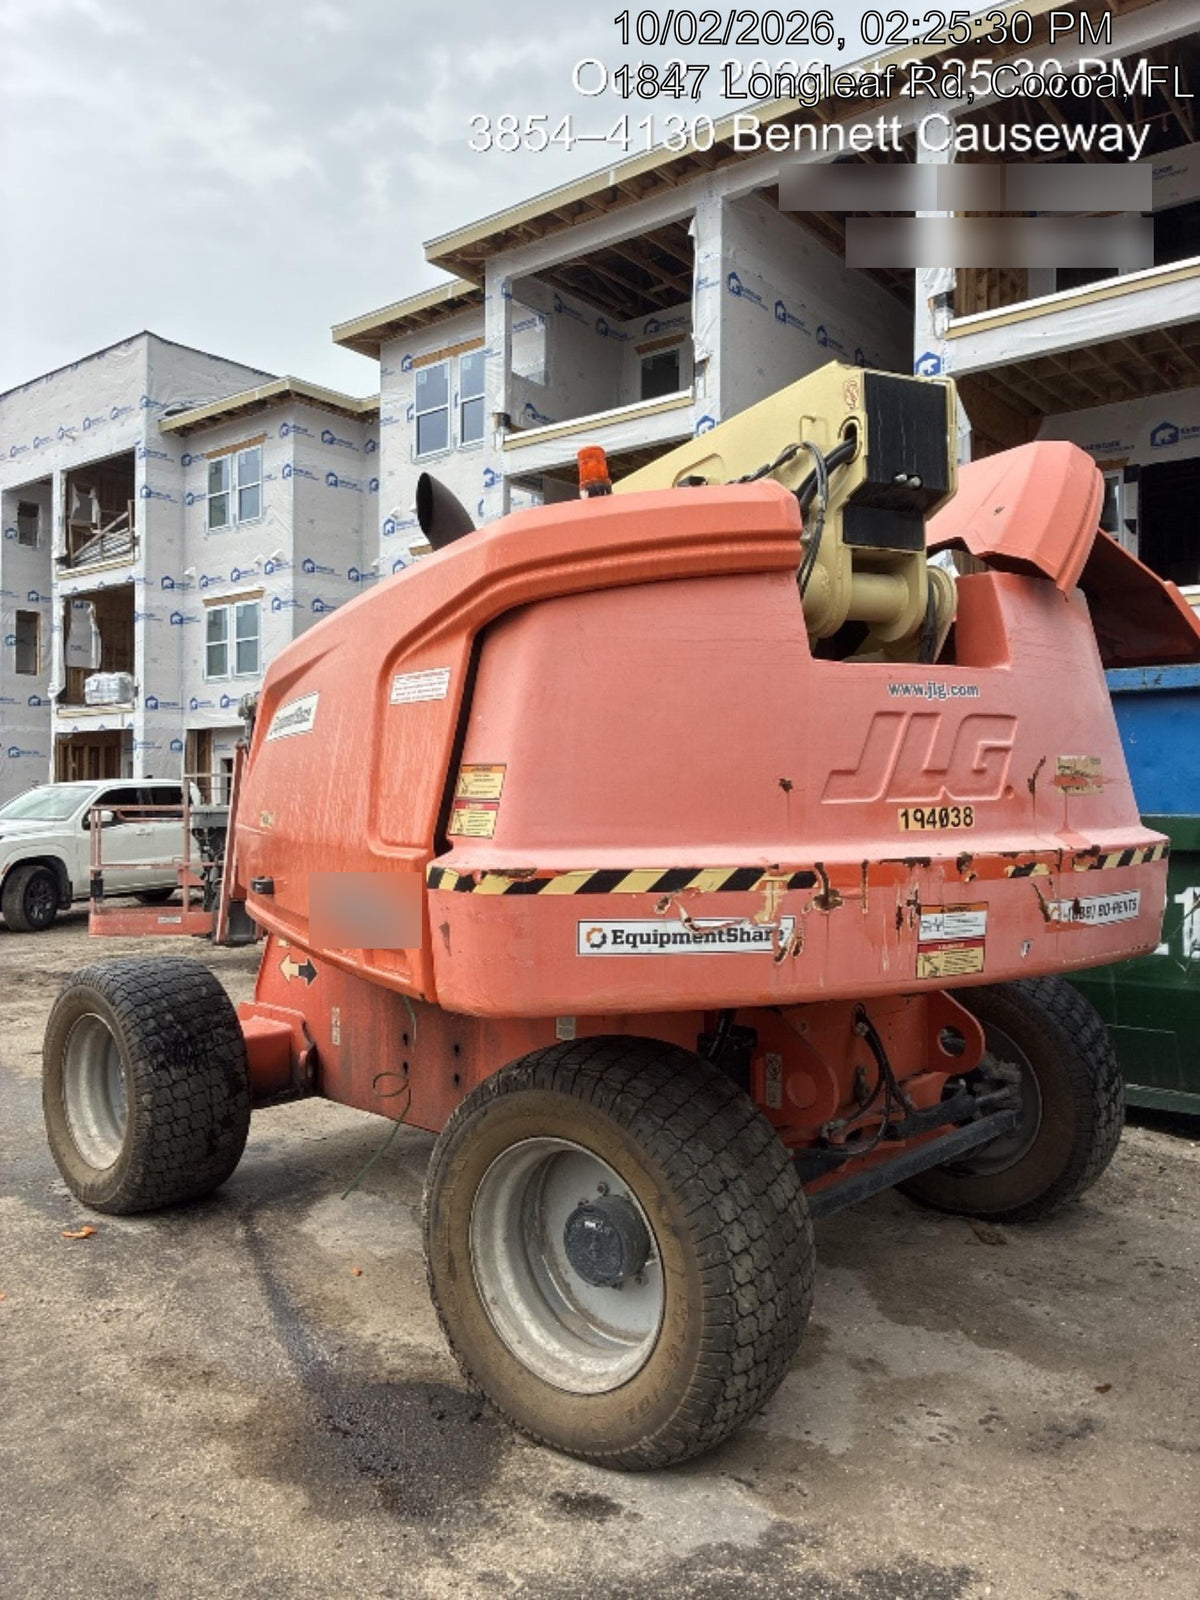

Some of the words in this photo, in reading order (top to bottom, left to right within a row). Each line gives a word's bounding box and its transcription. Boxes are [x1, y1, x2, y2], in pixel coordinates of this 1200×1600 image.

[888, 681, 980, 700] www.jlg.com
[822, 710, 1018, 804] JLG
[900, 806, 974, 830] 194038
